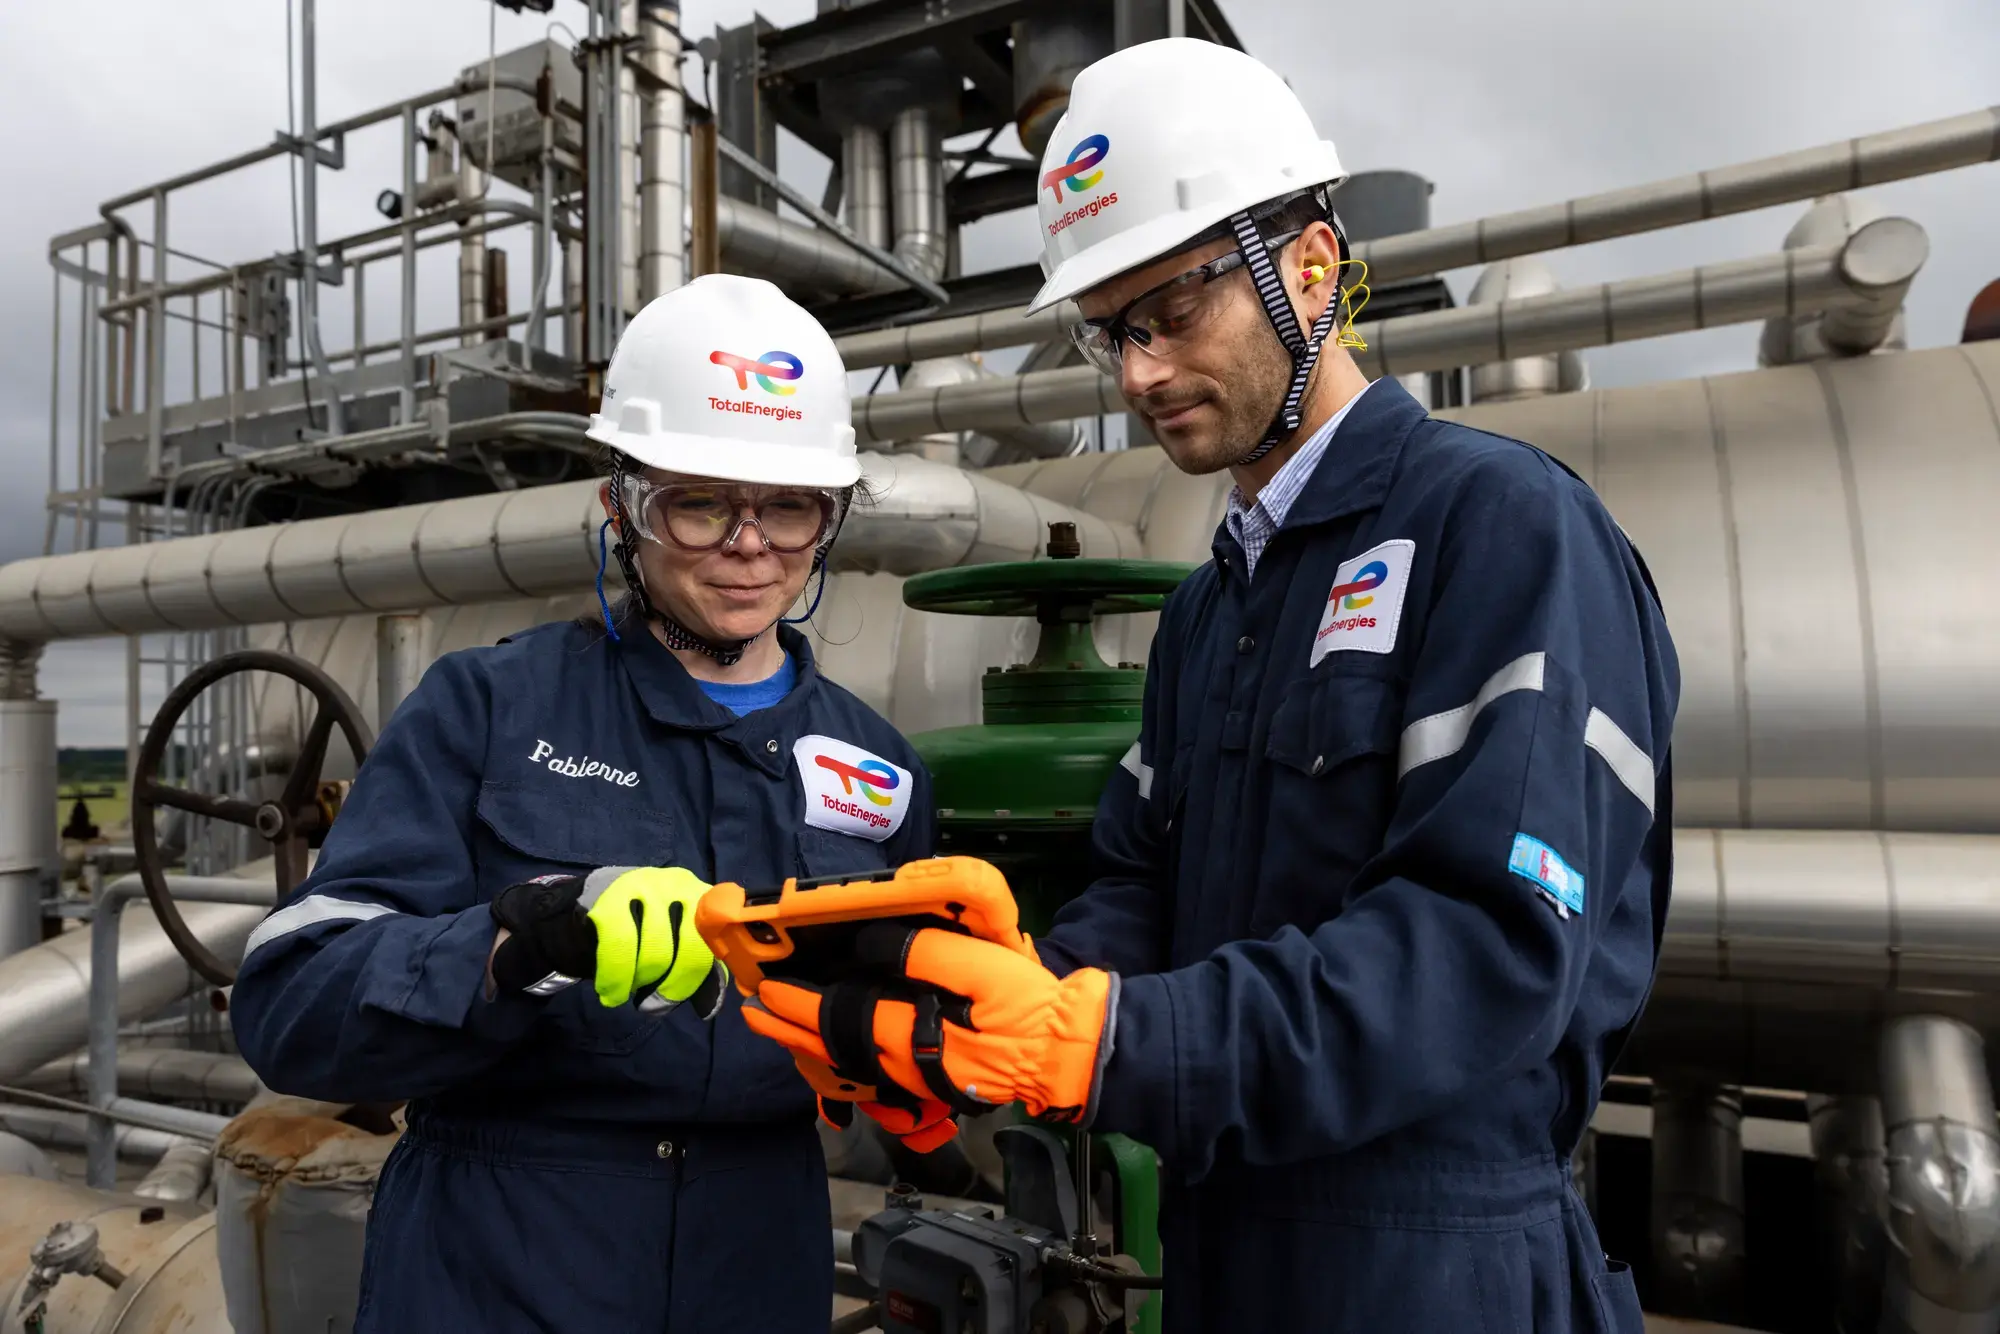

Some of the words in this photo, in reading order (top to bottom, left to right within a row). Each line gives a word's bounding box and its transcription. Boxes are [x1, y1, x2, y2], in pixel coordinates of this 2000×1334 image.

[1048, 192, 1118, 236] TotalEnergies
[708, 397, 802, 421] TotalEnergies
[528, 739, 640, 787] Fabienne
[821, 794, 891, 828] TotalEnergies
